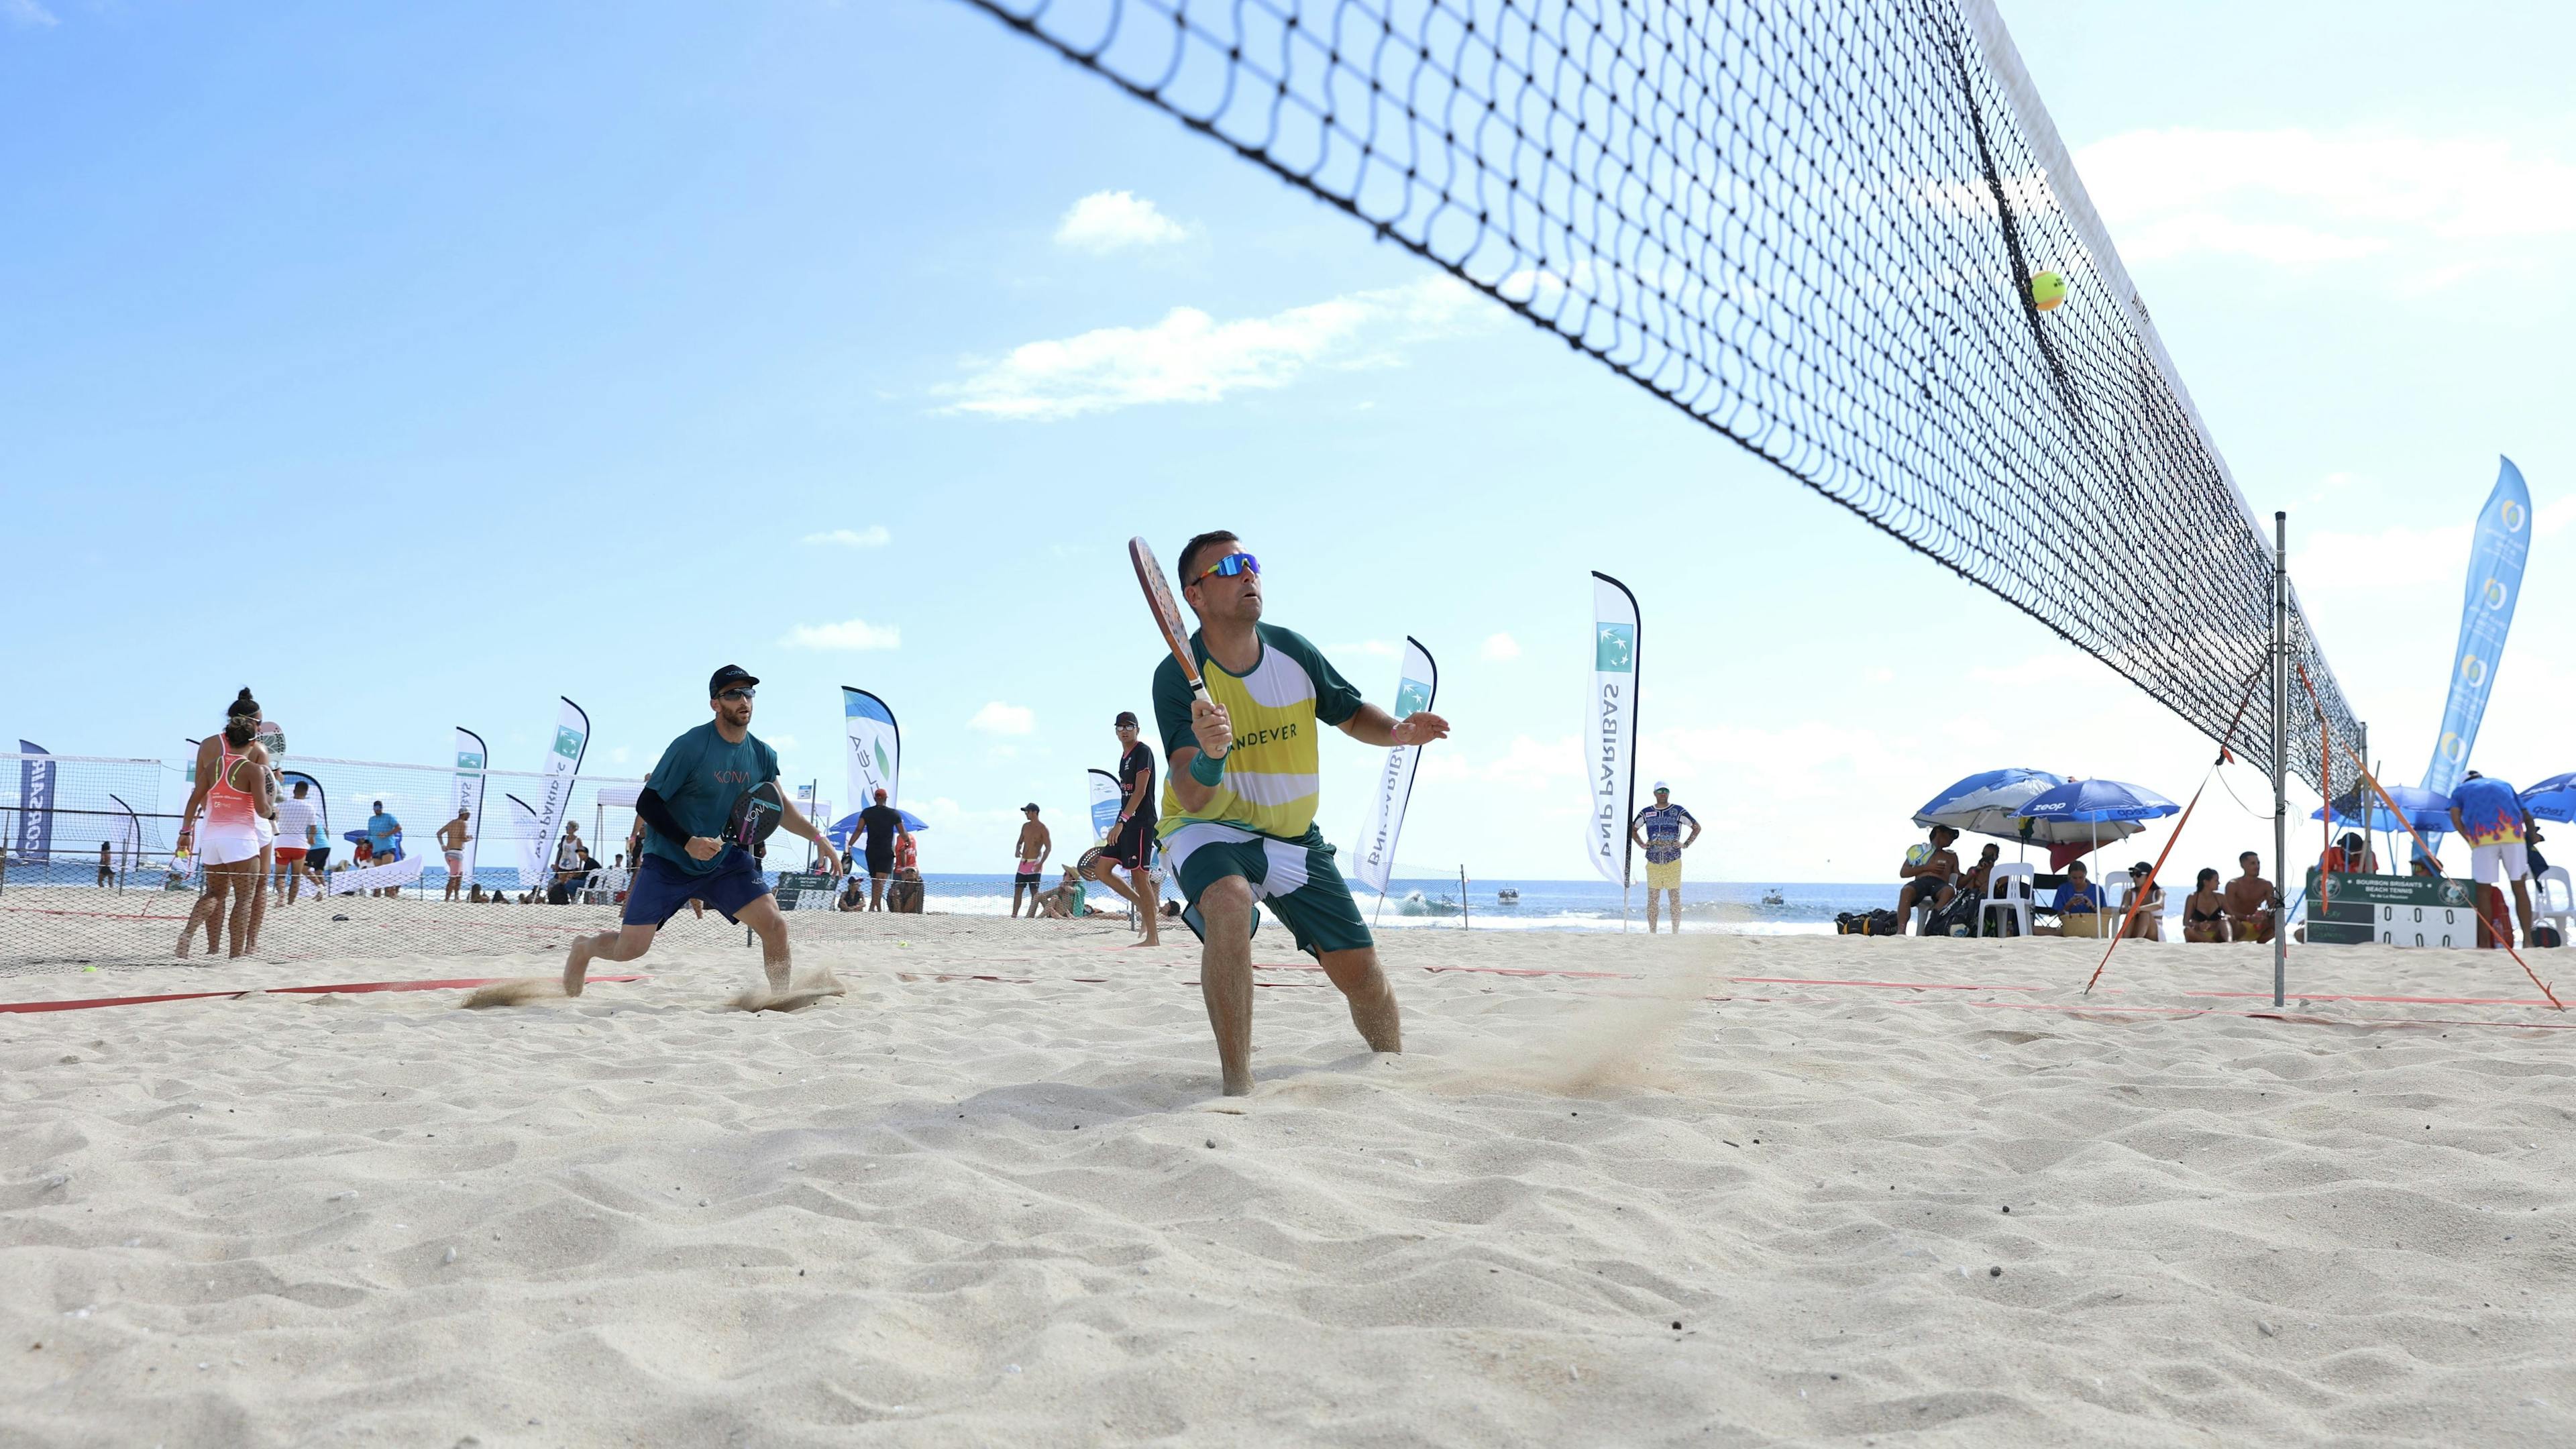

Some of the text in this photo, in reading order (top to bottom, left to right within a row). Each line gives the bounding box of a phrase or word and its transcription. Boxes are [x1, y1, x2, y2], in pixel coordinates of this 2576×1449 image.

[714, 770, 750, 784] KONA
[744, 802, 769, 822] KONA
[2033, 802, 2066, 811] zeop
[2390, 880, 2423, 888] BRISANTS
